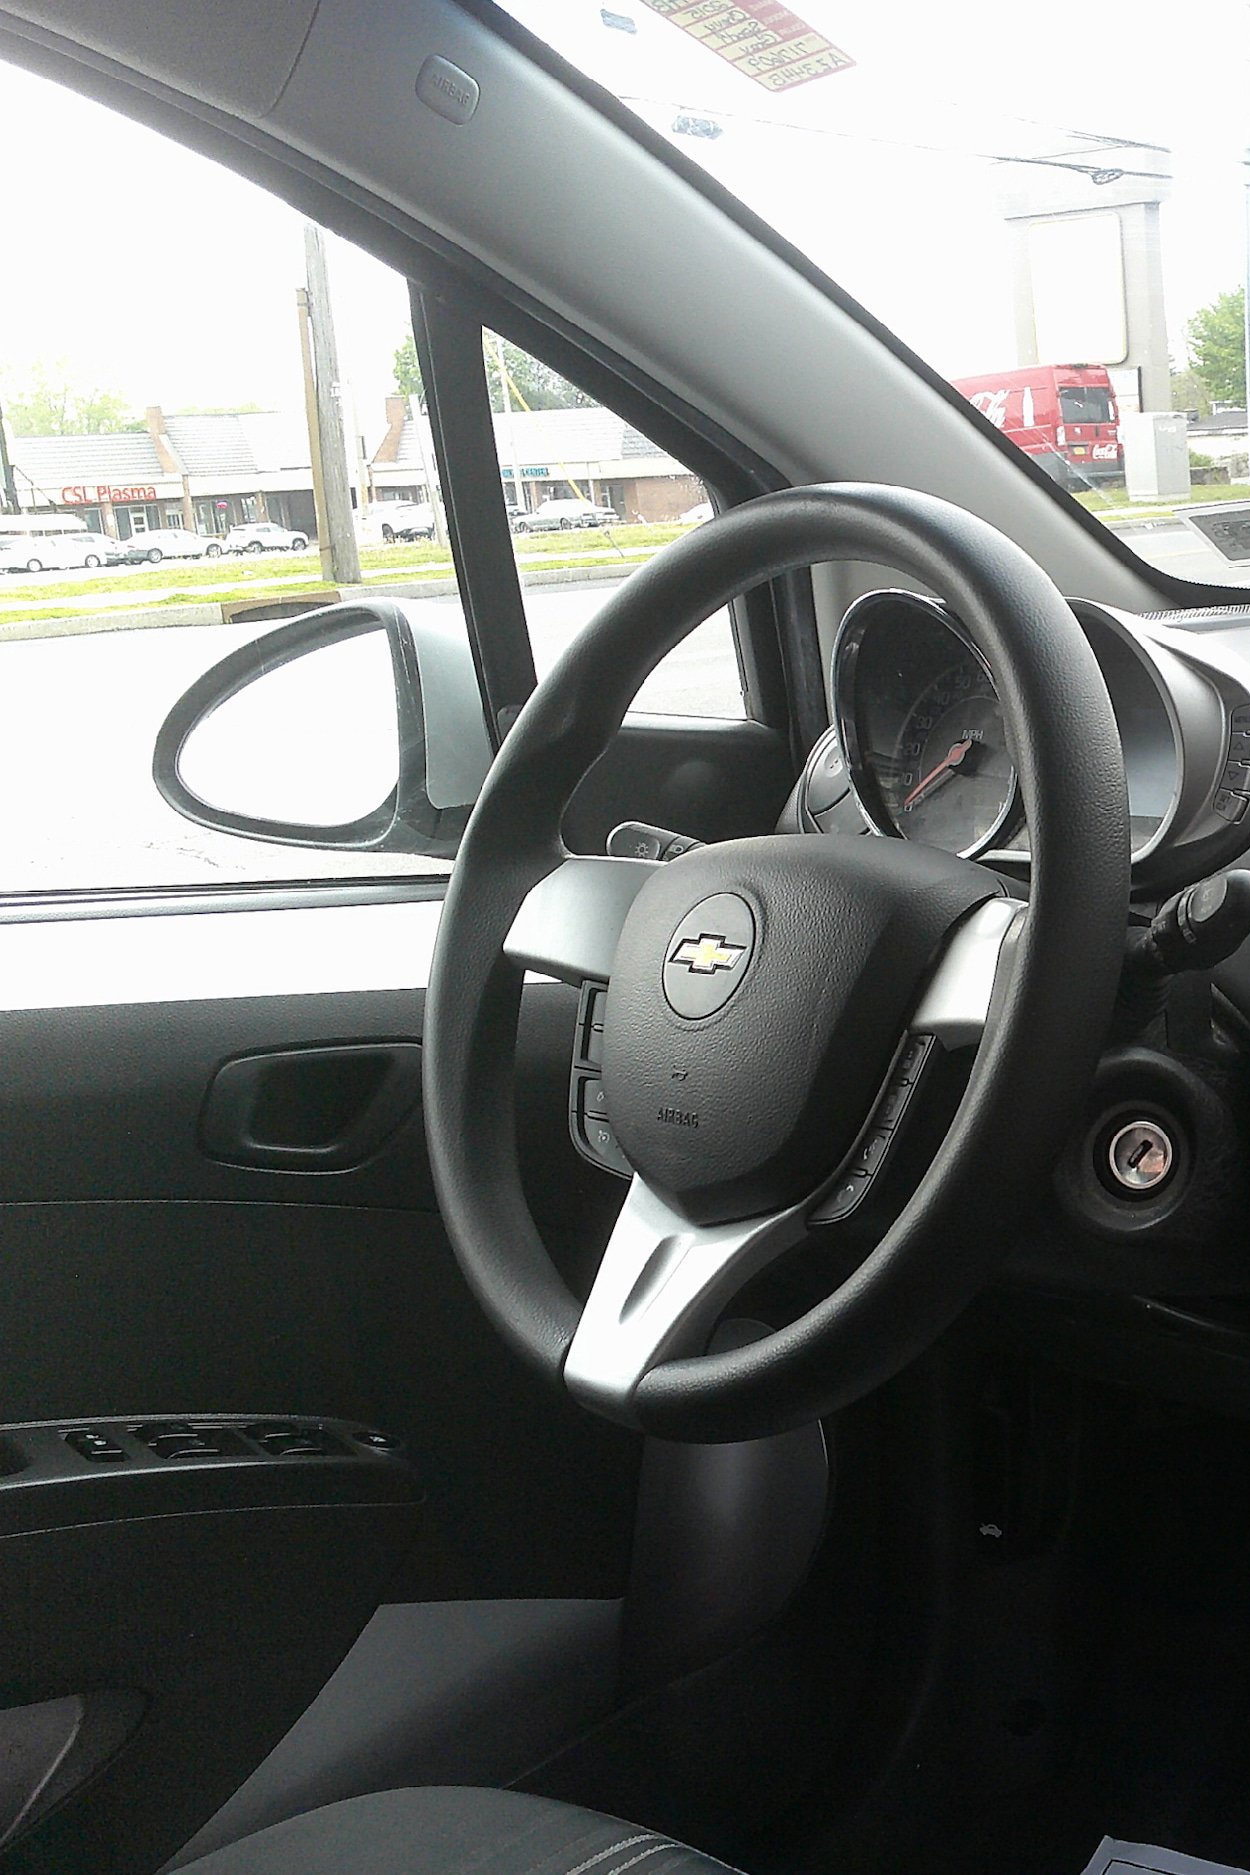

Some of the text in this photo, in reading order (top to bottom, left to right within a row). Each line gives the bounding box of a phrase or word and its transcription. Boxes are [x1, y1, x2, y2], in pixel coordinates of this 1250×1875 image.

[61, 484, 158, 505] CSL Plasma
[961, 729, 984, 741] MPH
[656, 1107, 699, 1129] AIRBAG
